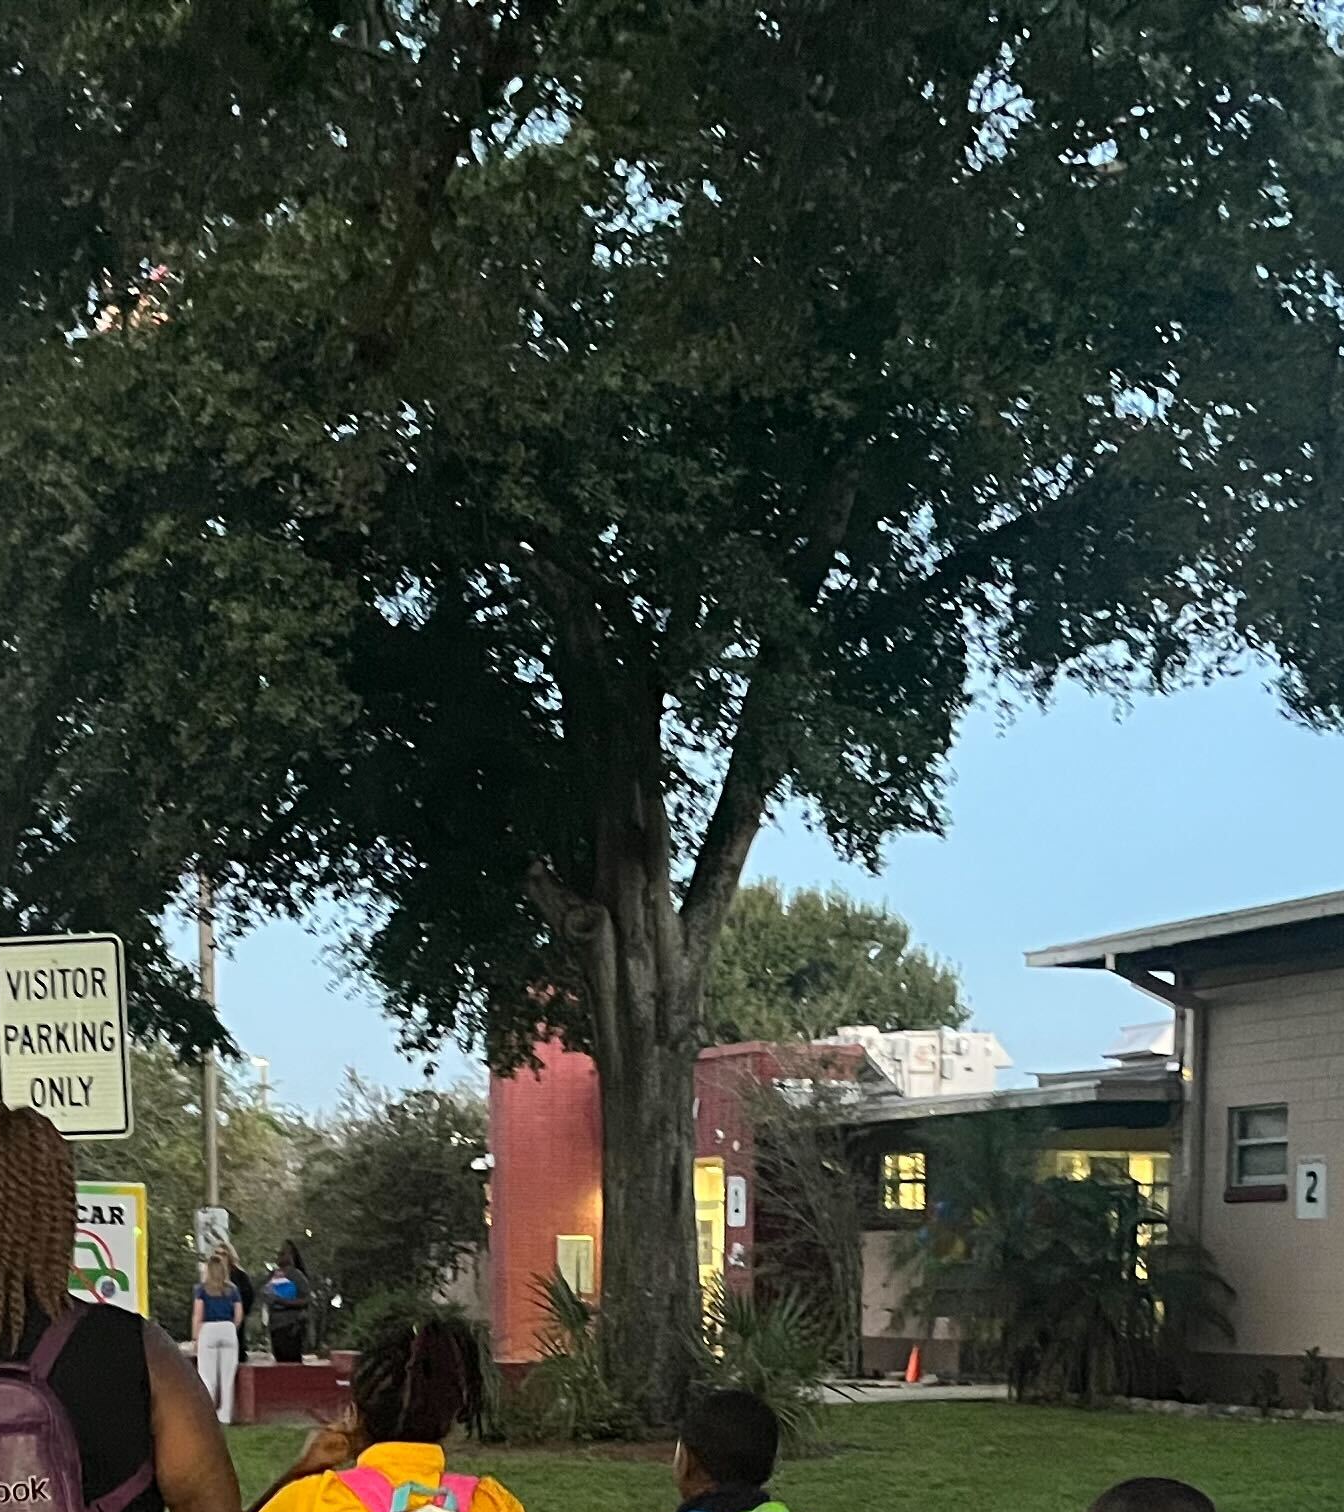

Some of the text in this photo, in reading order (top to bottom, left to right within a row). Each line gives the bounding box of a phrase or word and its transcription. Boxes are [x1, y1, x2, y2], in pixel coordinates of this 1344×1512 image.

[6, 967, 108, 1000] VISITOR
[5, 1020, 115, 1055] PARKING
[30, 1075, 93, 1108] ONLY
[1305, 1170, 1319, 1203] 2
[76, 1205, 125, 1225] CAR
